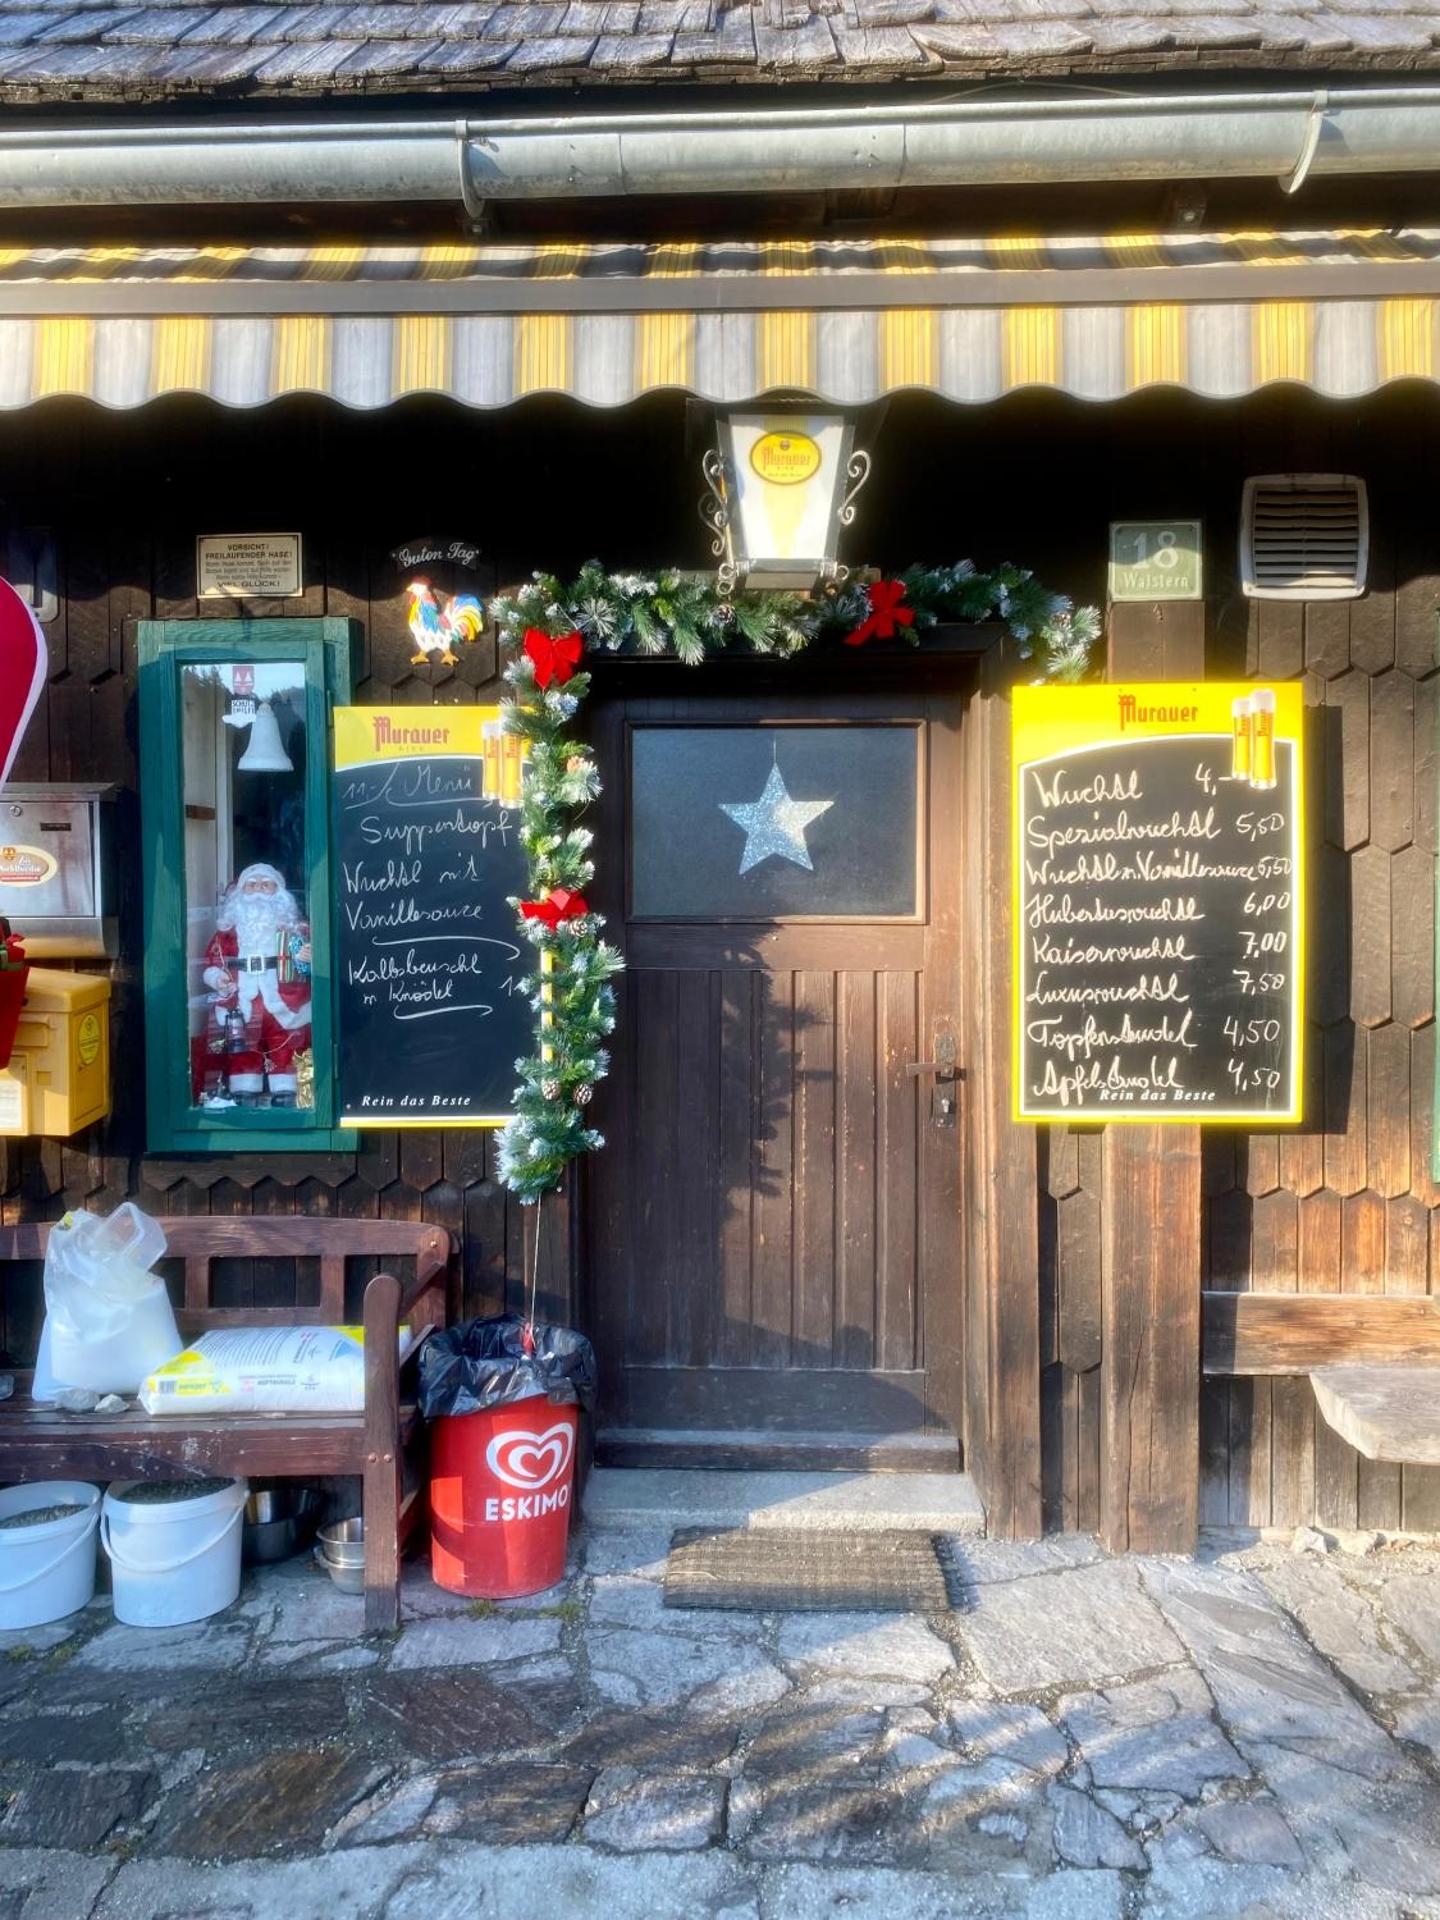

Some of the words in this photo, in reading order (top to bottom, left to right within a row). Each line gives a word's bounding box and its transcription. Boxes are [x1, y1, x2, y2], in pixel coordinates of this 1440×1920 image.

[227, 543, 270, 551] VORSICHT!
[399, 547, 443, 568] Guten
[447, 542, 476, 566] Tag
[1133, 531, 1179, 569] 18
[1123, 572, 1189, 589] Walstern
[1118, 694, 1199, 731] Murauer
[373, 716, 450, 752] Murauer
[1032, 770, 1143, 808] Wuchtl
[360, 809, 512, 855] Suppentopf
[1236, 812, 1285, 842] 5,50
[343, 860, 422, 893] Wuchtl
[439, 852, 484, 883] mit
[1026, 853, 1121, 885] Wuchtl
[1244, 892, 1291, 916] 6,00
[1239, 931, 1287, 959] 7,00
[389, 978, 454, 1002] Knödel
[1232, 969, 1285, 996] 7,50
[1223, 1016, 1280, 1047] 4,50
[1227, 1058, 1280, 1094] 4,50
[361, 1096, 394, 1107] Rein
[400, 1096, 425, 1107] das
[431, 1095, 471, 1107] Beste
[1100, 1089, 1134, 1101] Rein
[1141, 1089, 1167, 1101] das
[1174, 1089, 1216, 1101] Beste
[486, 1484, 568, 1521] ESKIMO
